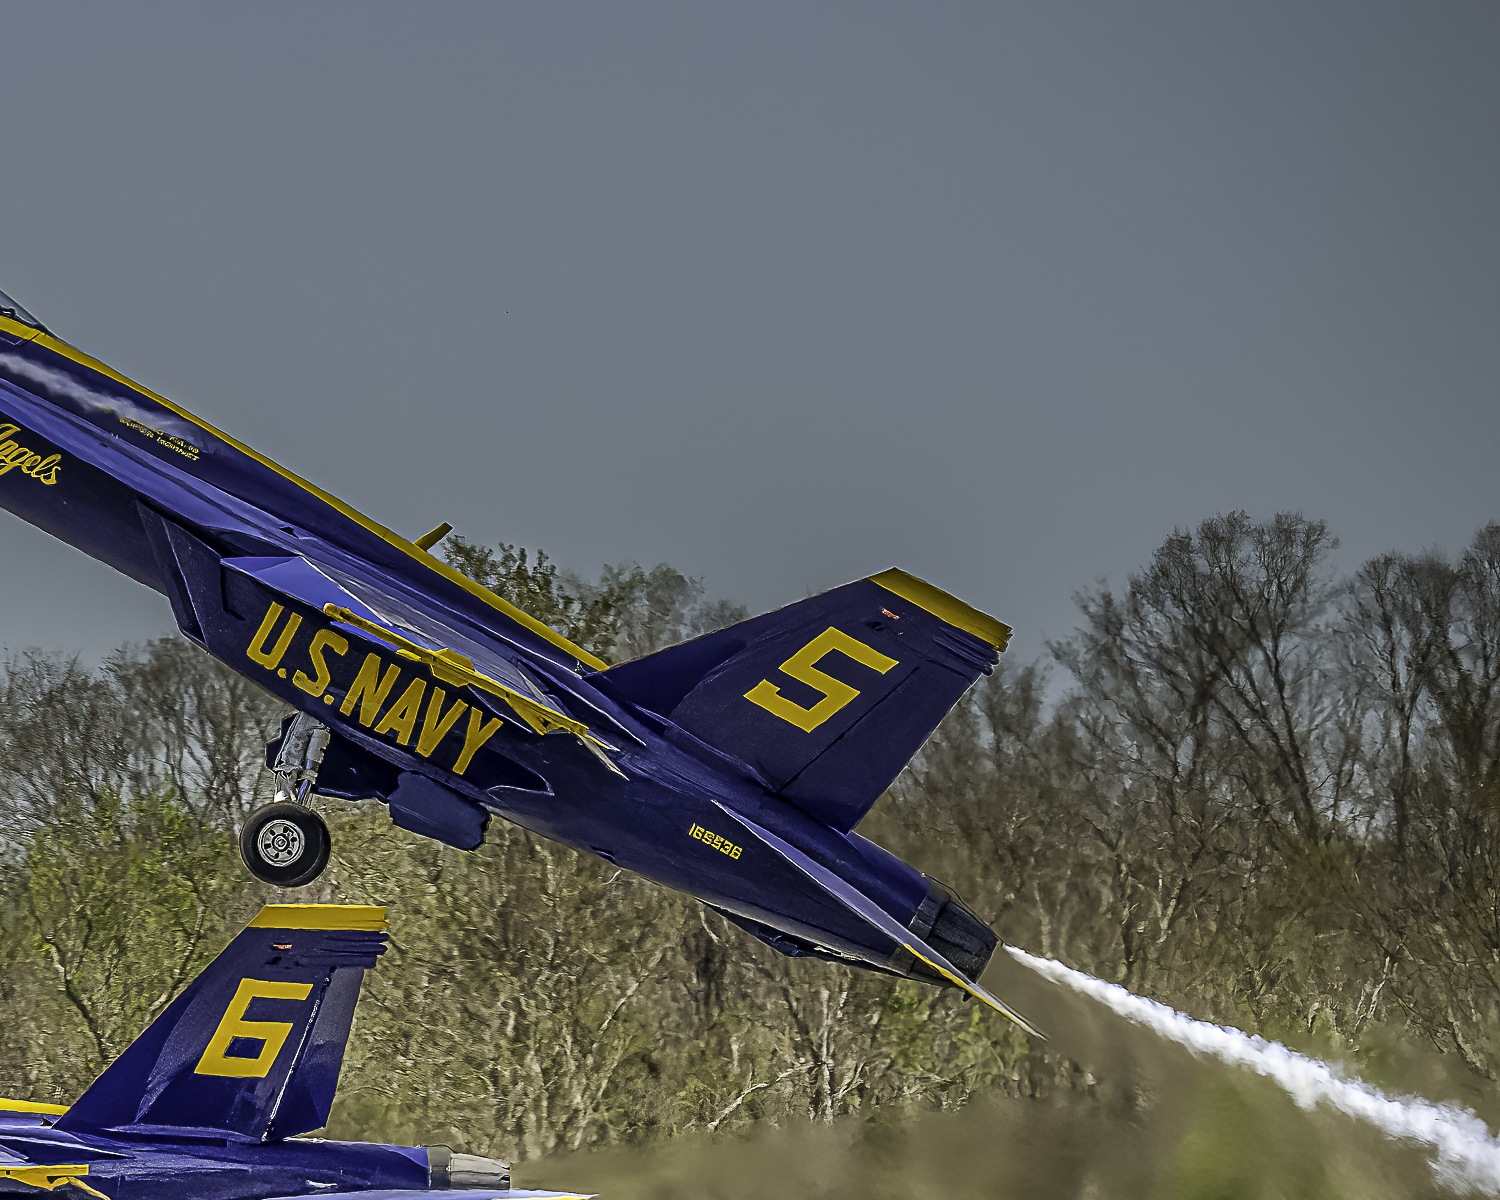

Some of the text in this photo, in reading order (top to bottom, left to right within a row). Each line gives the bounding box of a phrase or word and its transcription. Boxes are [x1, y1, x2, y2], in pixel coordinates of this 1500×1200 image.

[246, 601, 504, 775] U.S. NAVY
[743, 626, 900, 733] 5
[688, 822, 743, 860] 165536
[194, 978, 314, 1078] 6
